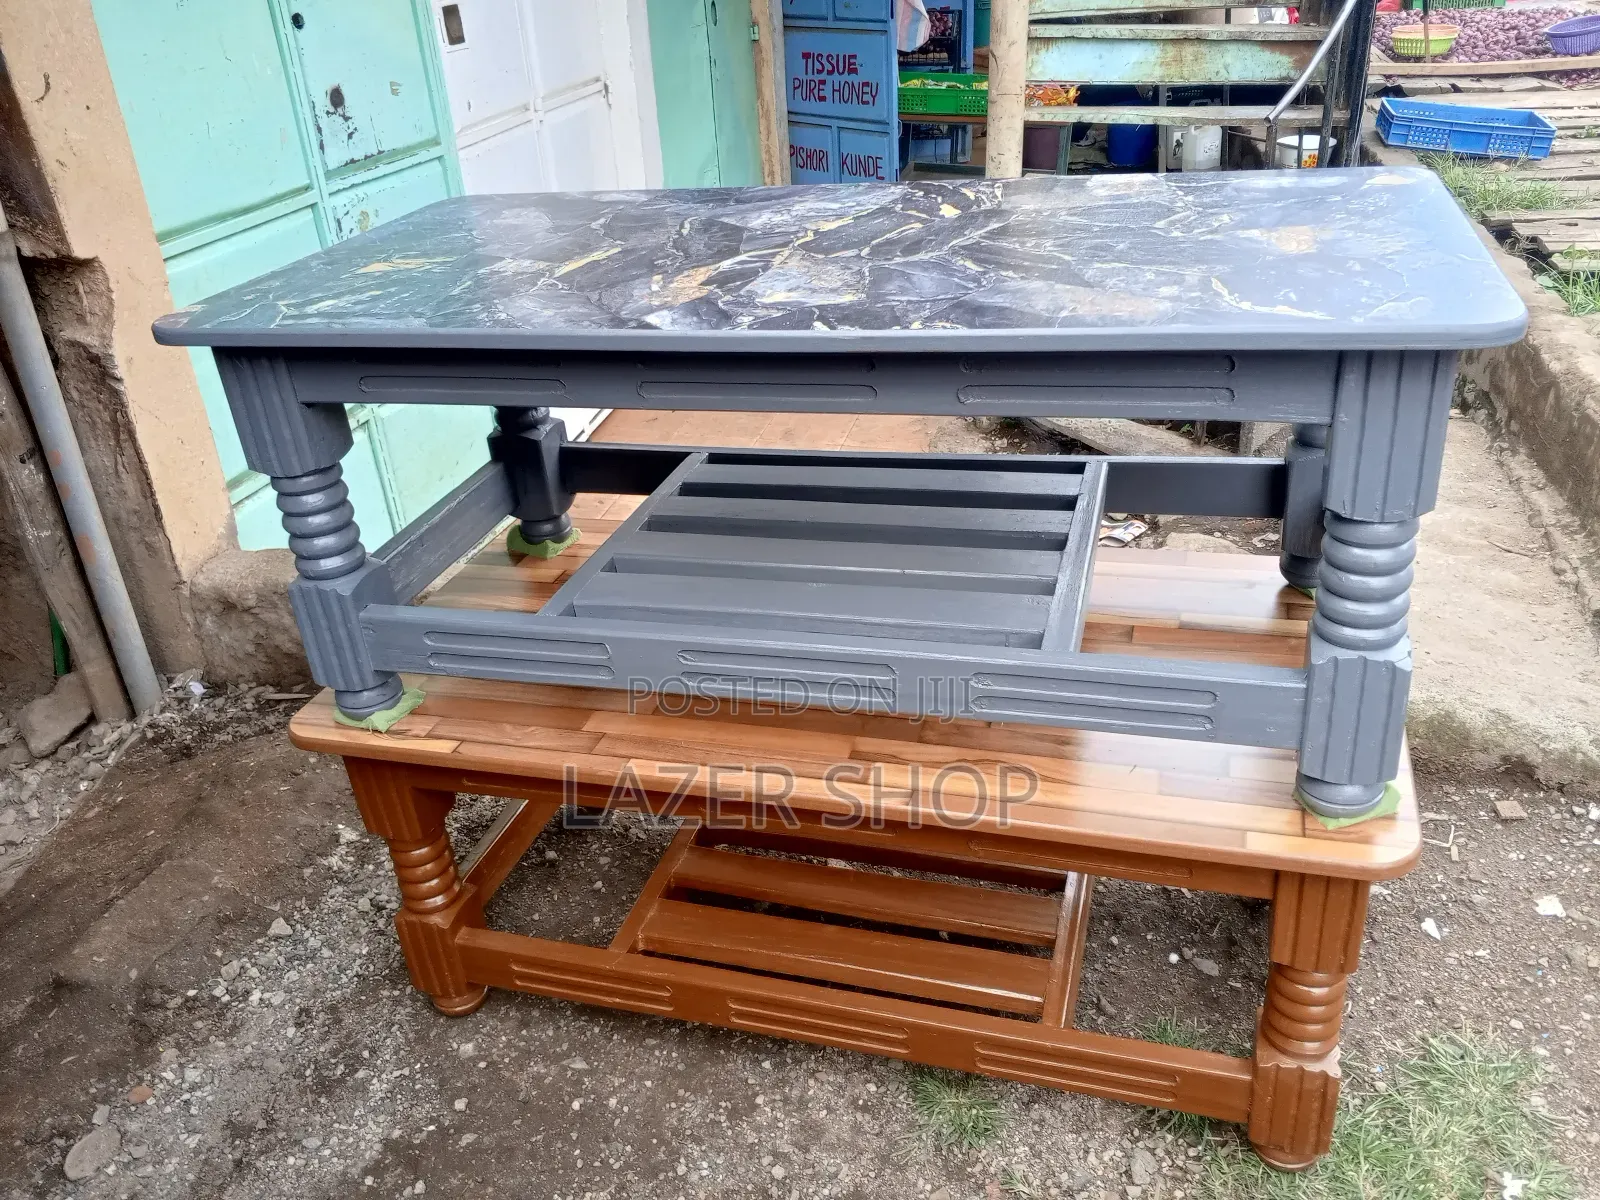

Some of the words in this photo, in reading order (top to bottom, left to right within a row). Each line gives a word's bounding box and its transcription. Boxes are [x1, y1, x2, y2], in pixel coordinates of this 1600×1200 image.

[801, 52, 858, 76] TISSUE
[792, 77, 826, 103] PURE
[832, 80, 879, 107] HONEY
[789, 144, 828, 172] PISHORI
[841, 152, 884, 180] KUNDE
